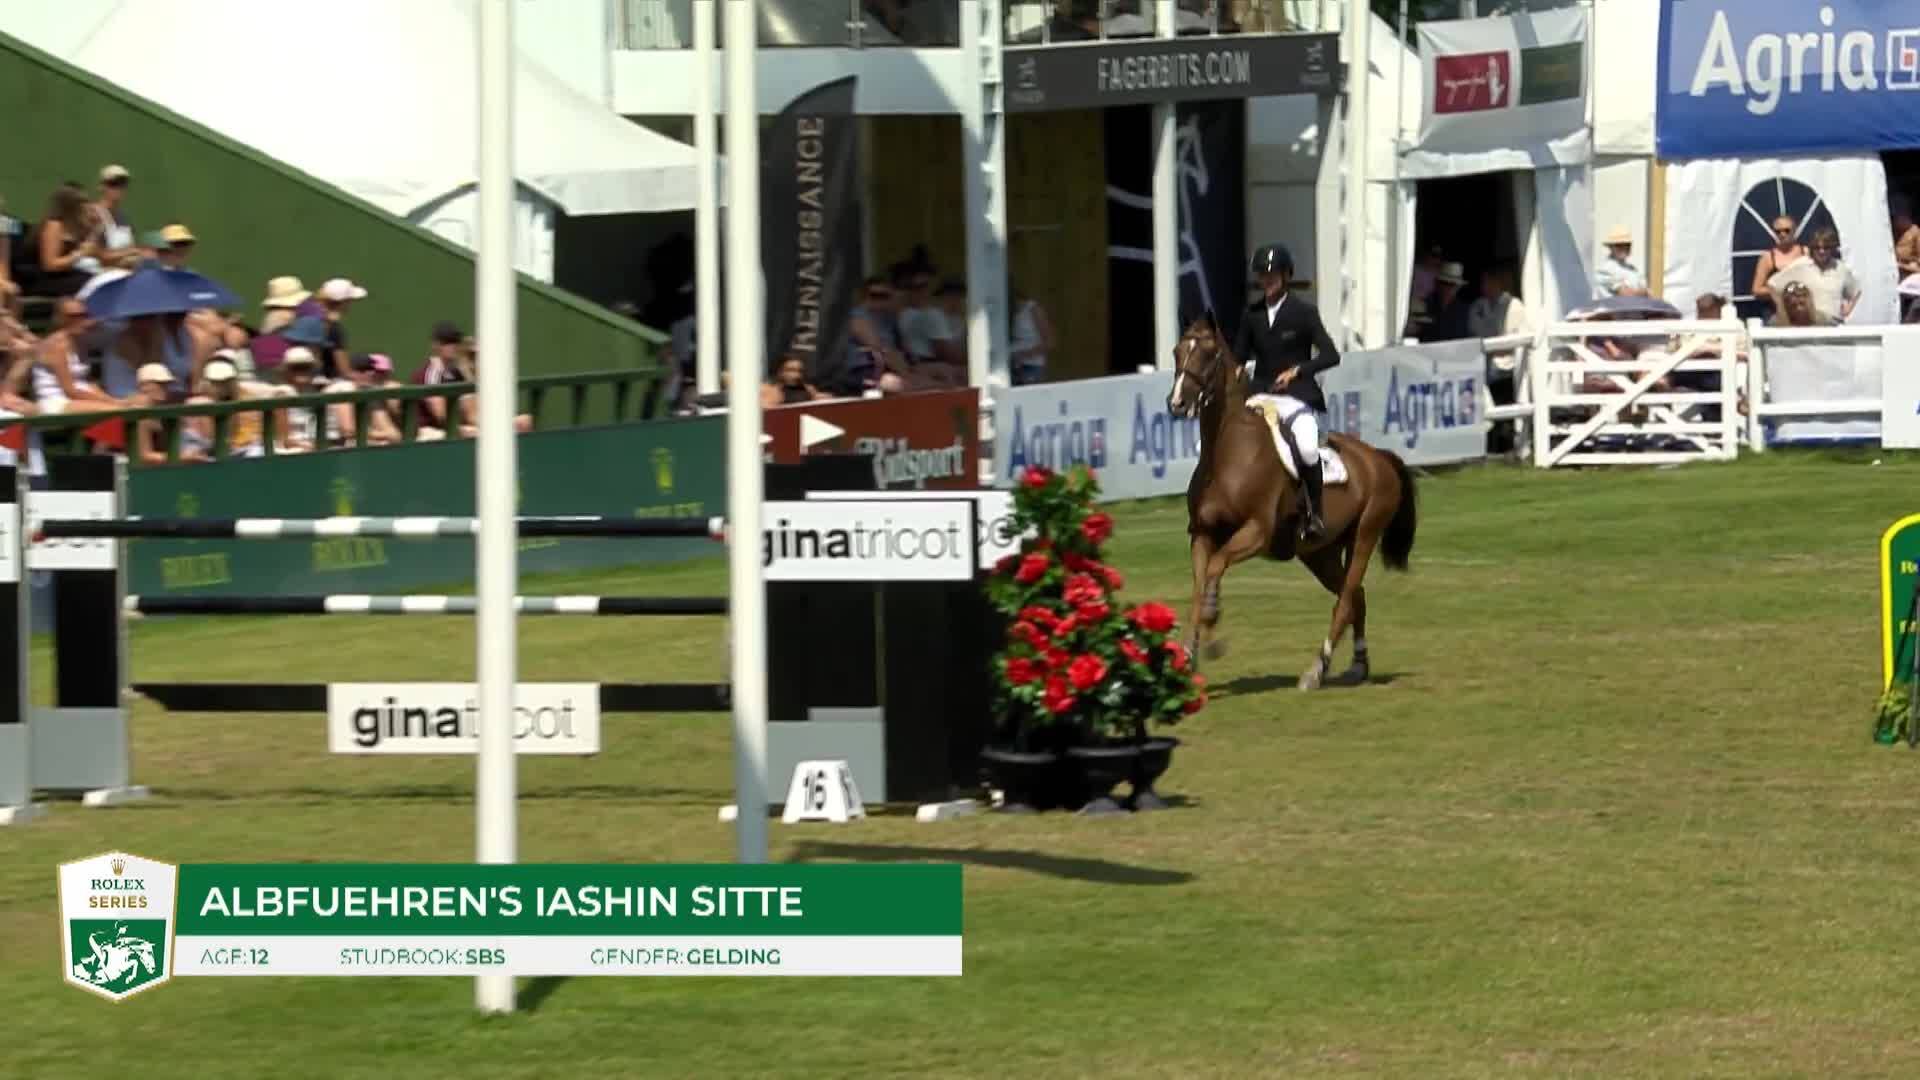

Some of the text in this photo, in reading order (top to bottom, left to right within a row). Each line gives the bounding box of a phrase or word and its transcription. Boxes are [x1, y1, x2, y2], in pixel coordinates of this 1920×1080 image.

[1098, 51, 1250, 90] FAGERBITS.COM
[1691, 6, 1879, 115] Agria
[792, 117, 824, 352] RENAISSANCE
[1130, 392, 1201, 478] Agri
[1384, 364, 1457, 449] Agria
[352, 695, 578, 747] ginatcot
[803, 769, 828, 811] 16
